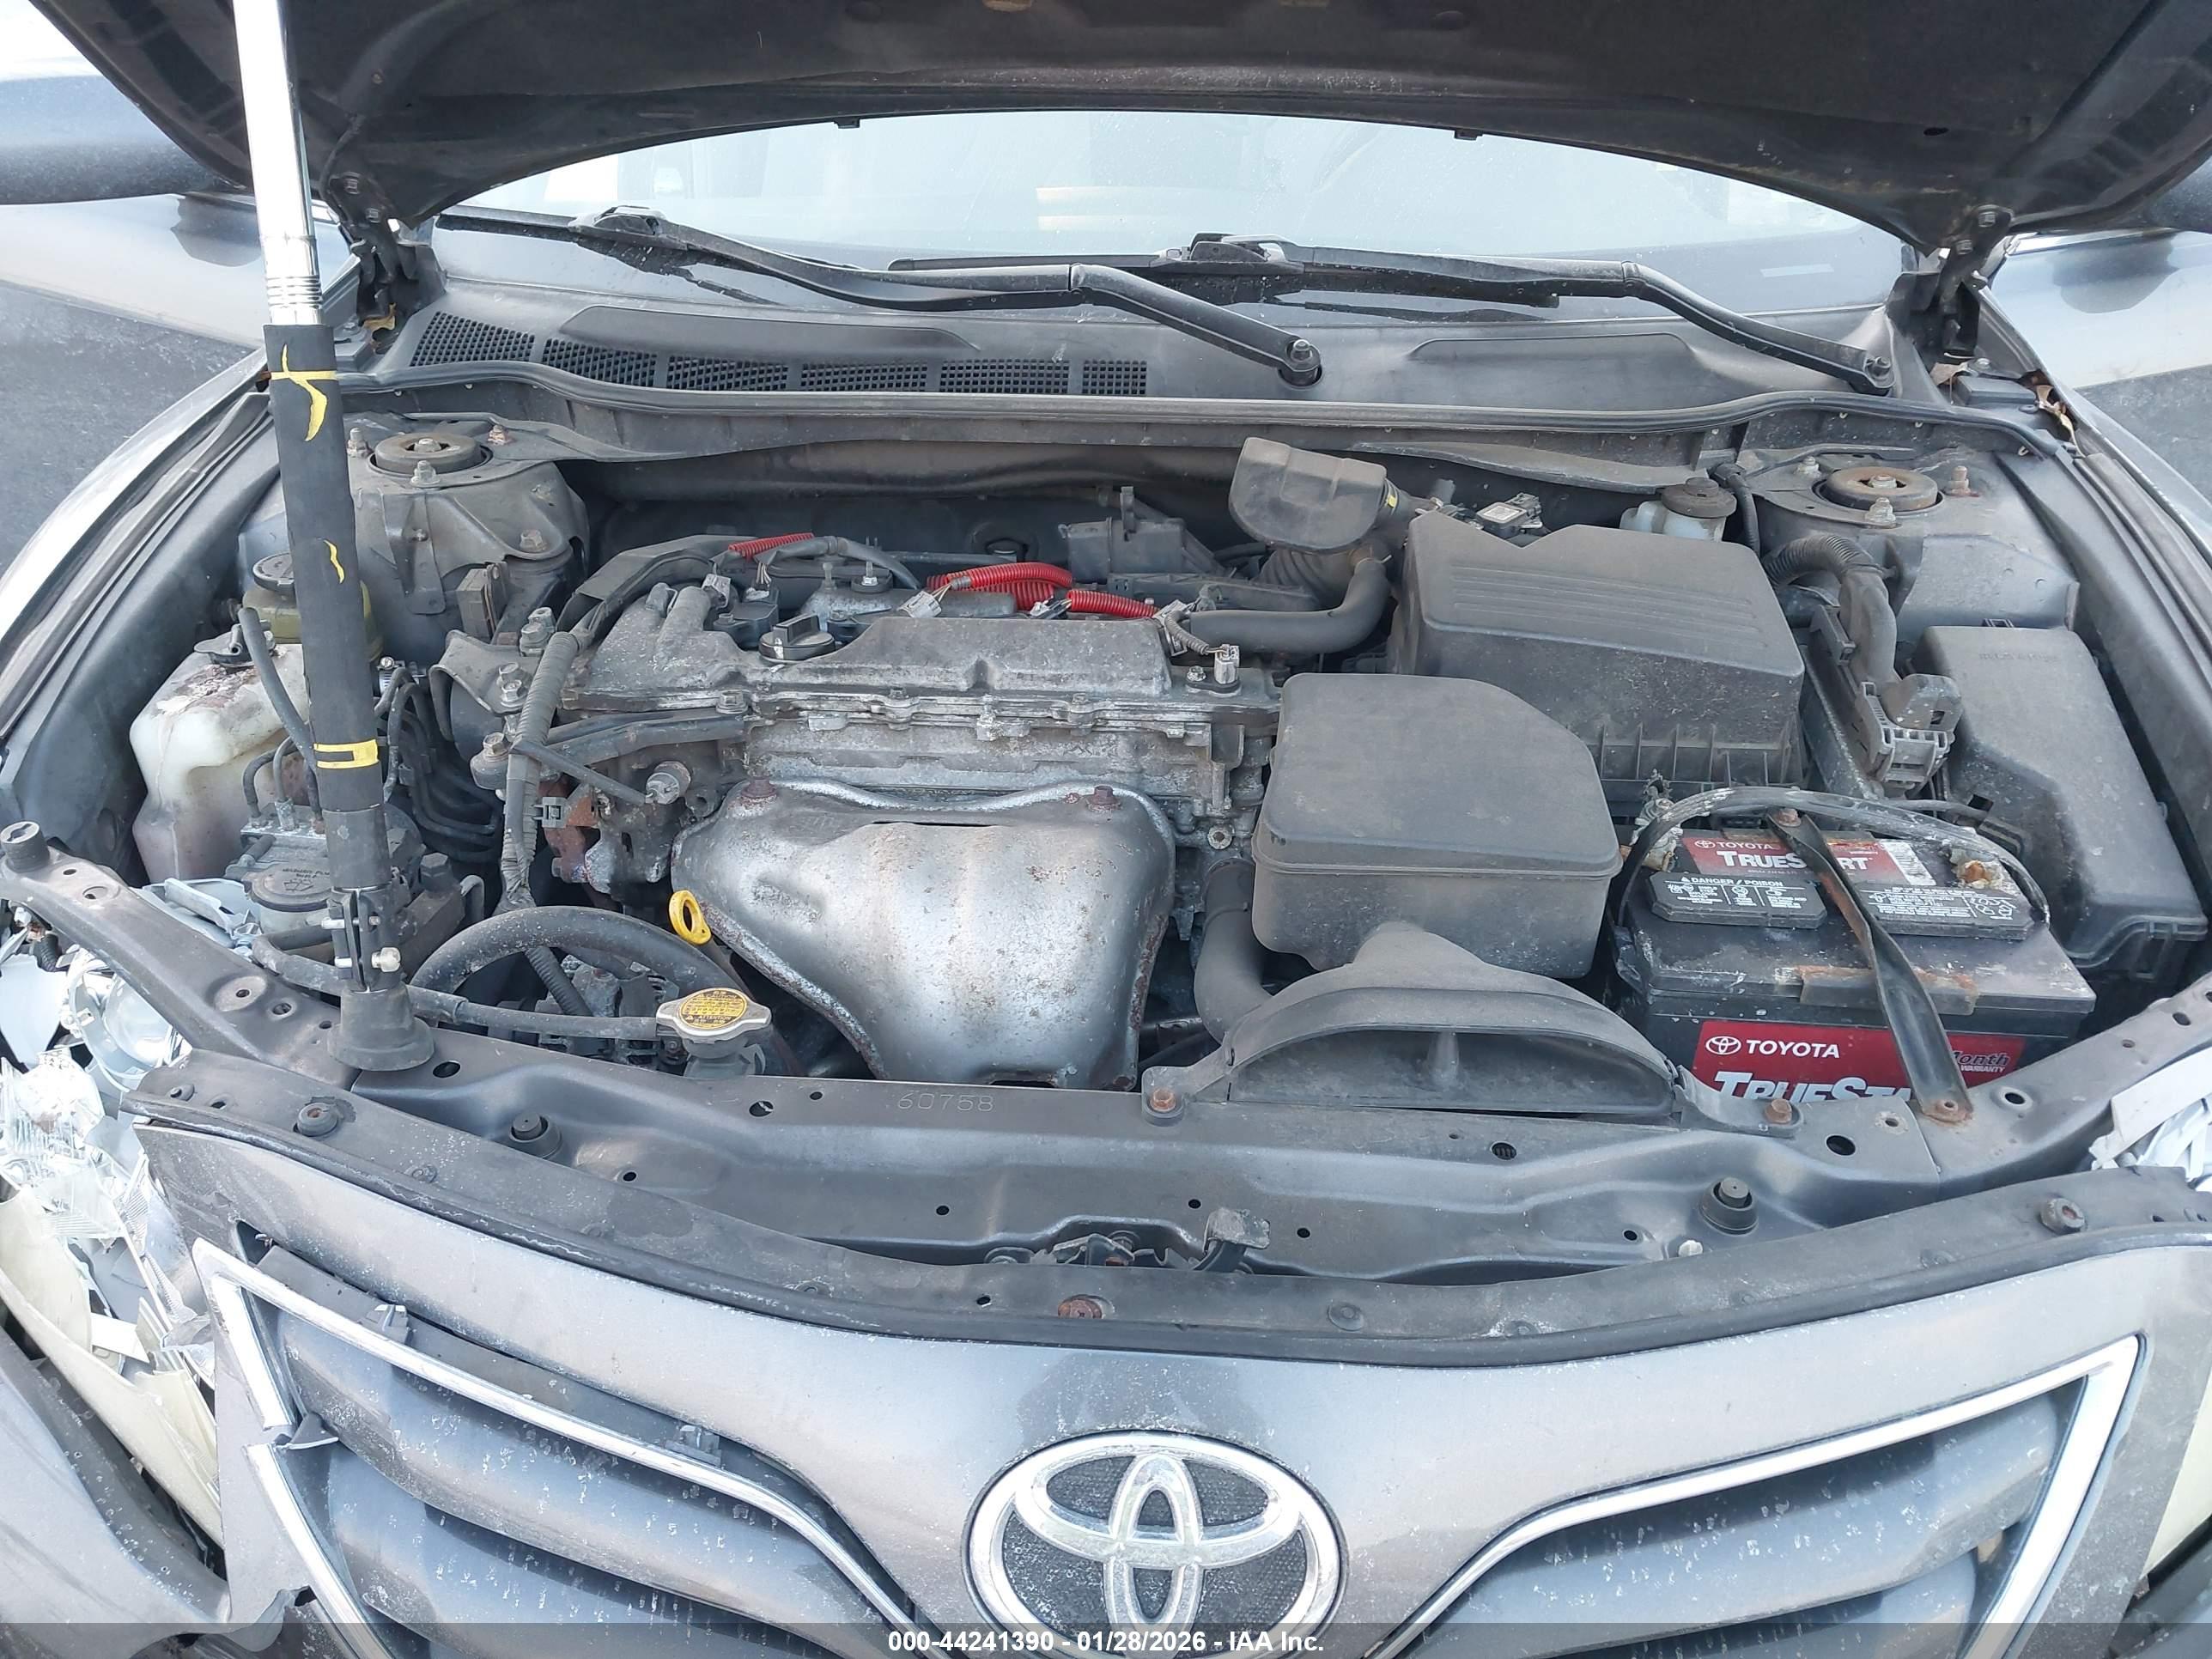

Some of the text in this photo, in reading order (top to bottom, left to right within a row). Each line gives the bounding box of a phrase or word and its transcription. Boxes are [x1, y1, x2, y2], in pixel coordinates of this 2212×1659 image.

[1717, 842, 1773, 850] TOYOTA
[1691, 877, 1735, 885] DANGER
[1746, 1039, 1840, 1059] TOYOTA
[897, 1092, 994, 1112] 60758
